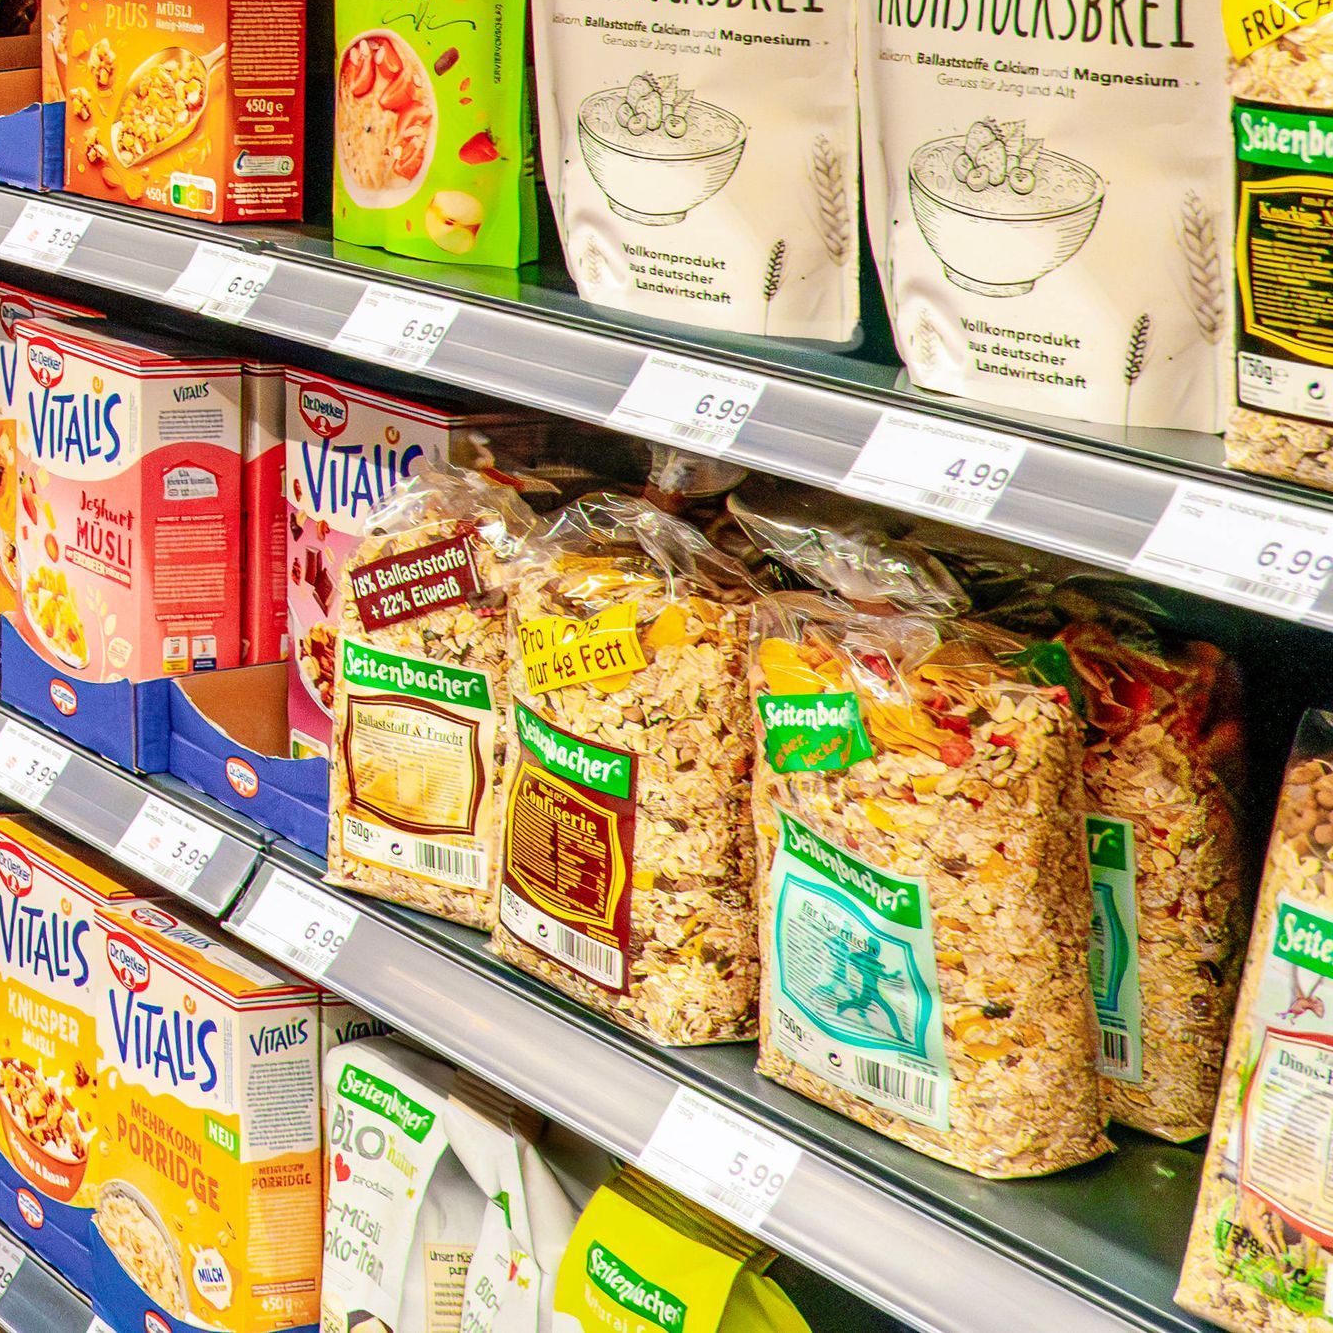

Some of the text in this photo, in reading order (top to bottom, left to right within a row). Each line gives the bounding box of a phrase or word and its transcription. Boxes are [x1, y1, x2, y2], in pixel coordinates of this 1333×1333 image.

[104, 0, 193, 30] PLUS MÜSLI
[719, 28, 811, 49] Magnesium
[1073, 65, 1180, 91] Magnesium
[46, 226, 79, 250] 3.99
[621, 240, 727, 272] Vollkornprodukt
[227, 275, 264, 297] 6.99
[634, 278, 732, 305] Landwirtschaft
[651, 261, 717, 287] deutscher
[400, 316, 446, 345] 6.99
[959, 316, 1082, 351] Vollkornprodukt
[967, 339, 1068, 369] aus deutscher
[975, 358, 1088, 390] Landwirtschaft
[693, 391, 750, 424] 6.99
[944, 457, 1011, 492] 4.99
[78, 490, 134, 531] Joghurt
[76, 518, 133, 568] MÜSLI
[1255, 540, 1332, 581] 6.99
[353, 547, 467, 601] 18% Ballaststoffe
[380, 576, 461, 618] 22% Eiweiß
[520, 627, 544, 651] Pro
[344, 647, 475, 699] Seitenbacher
[527, 638, 628, 687] nur 4g Fett
[519, 711, 618, 784] Seitenbacher
[24, 757, 59, 786] 3.99
[522, 779, 597, 836] Confiserie
[170, 841, 210, 871] 3.99
[788, 819, 909, 912] Seitenbacher
[303, 920, 346, 954] 6.99
[8, 988, 82, 1051] KNUSPER
[777, 1007, 804, 1044] 750g
[21, 1023, 58, 1061] MÜSLI
[342, 1069, 429, 1130] Seitenbacher
[129, 1097, 204, 1163] MEHRKORN
[206, 1120, 237, 1153] NEU
[116, 1116, 221, 1215] PORRIDGE
[727, 1152, 787, 1197] 5.99
[198, 1262, 226, 1289] MILCH
[589, 1246, 684, 1323] Seitenbacher
